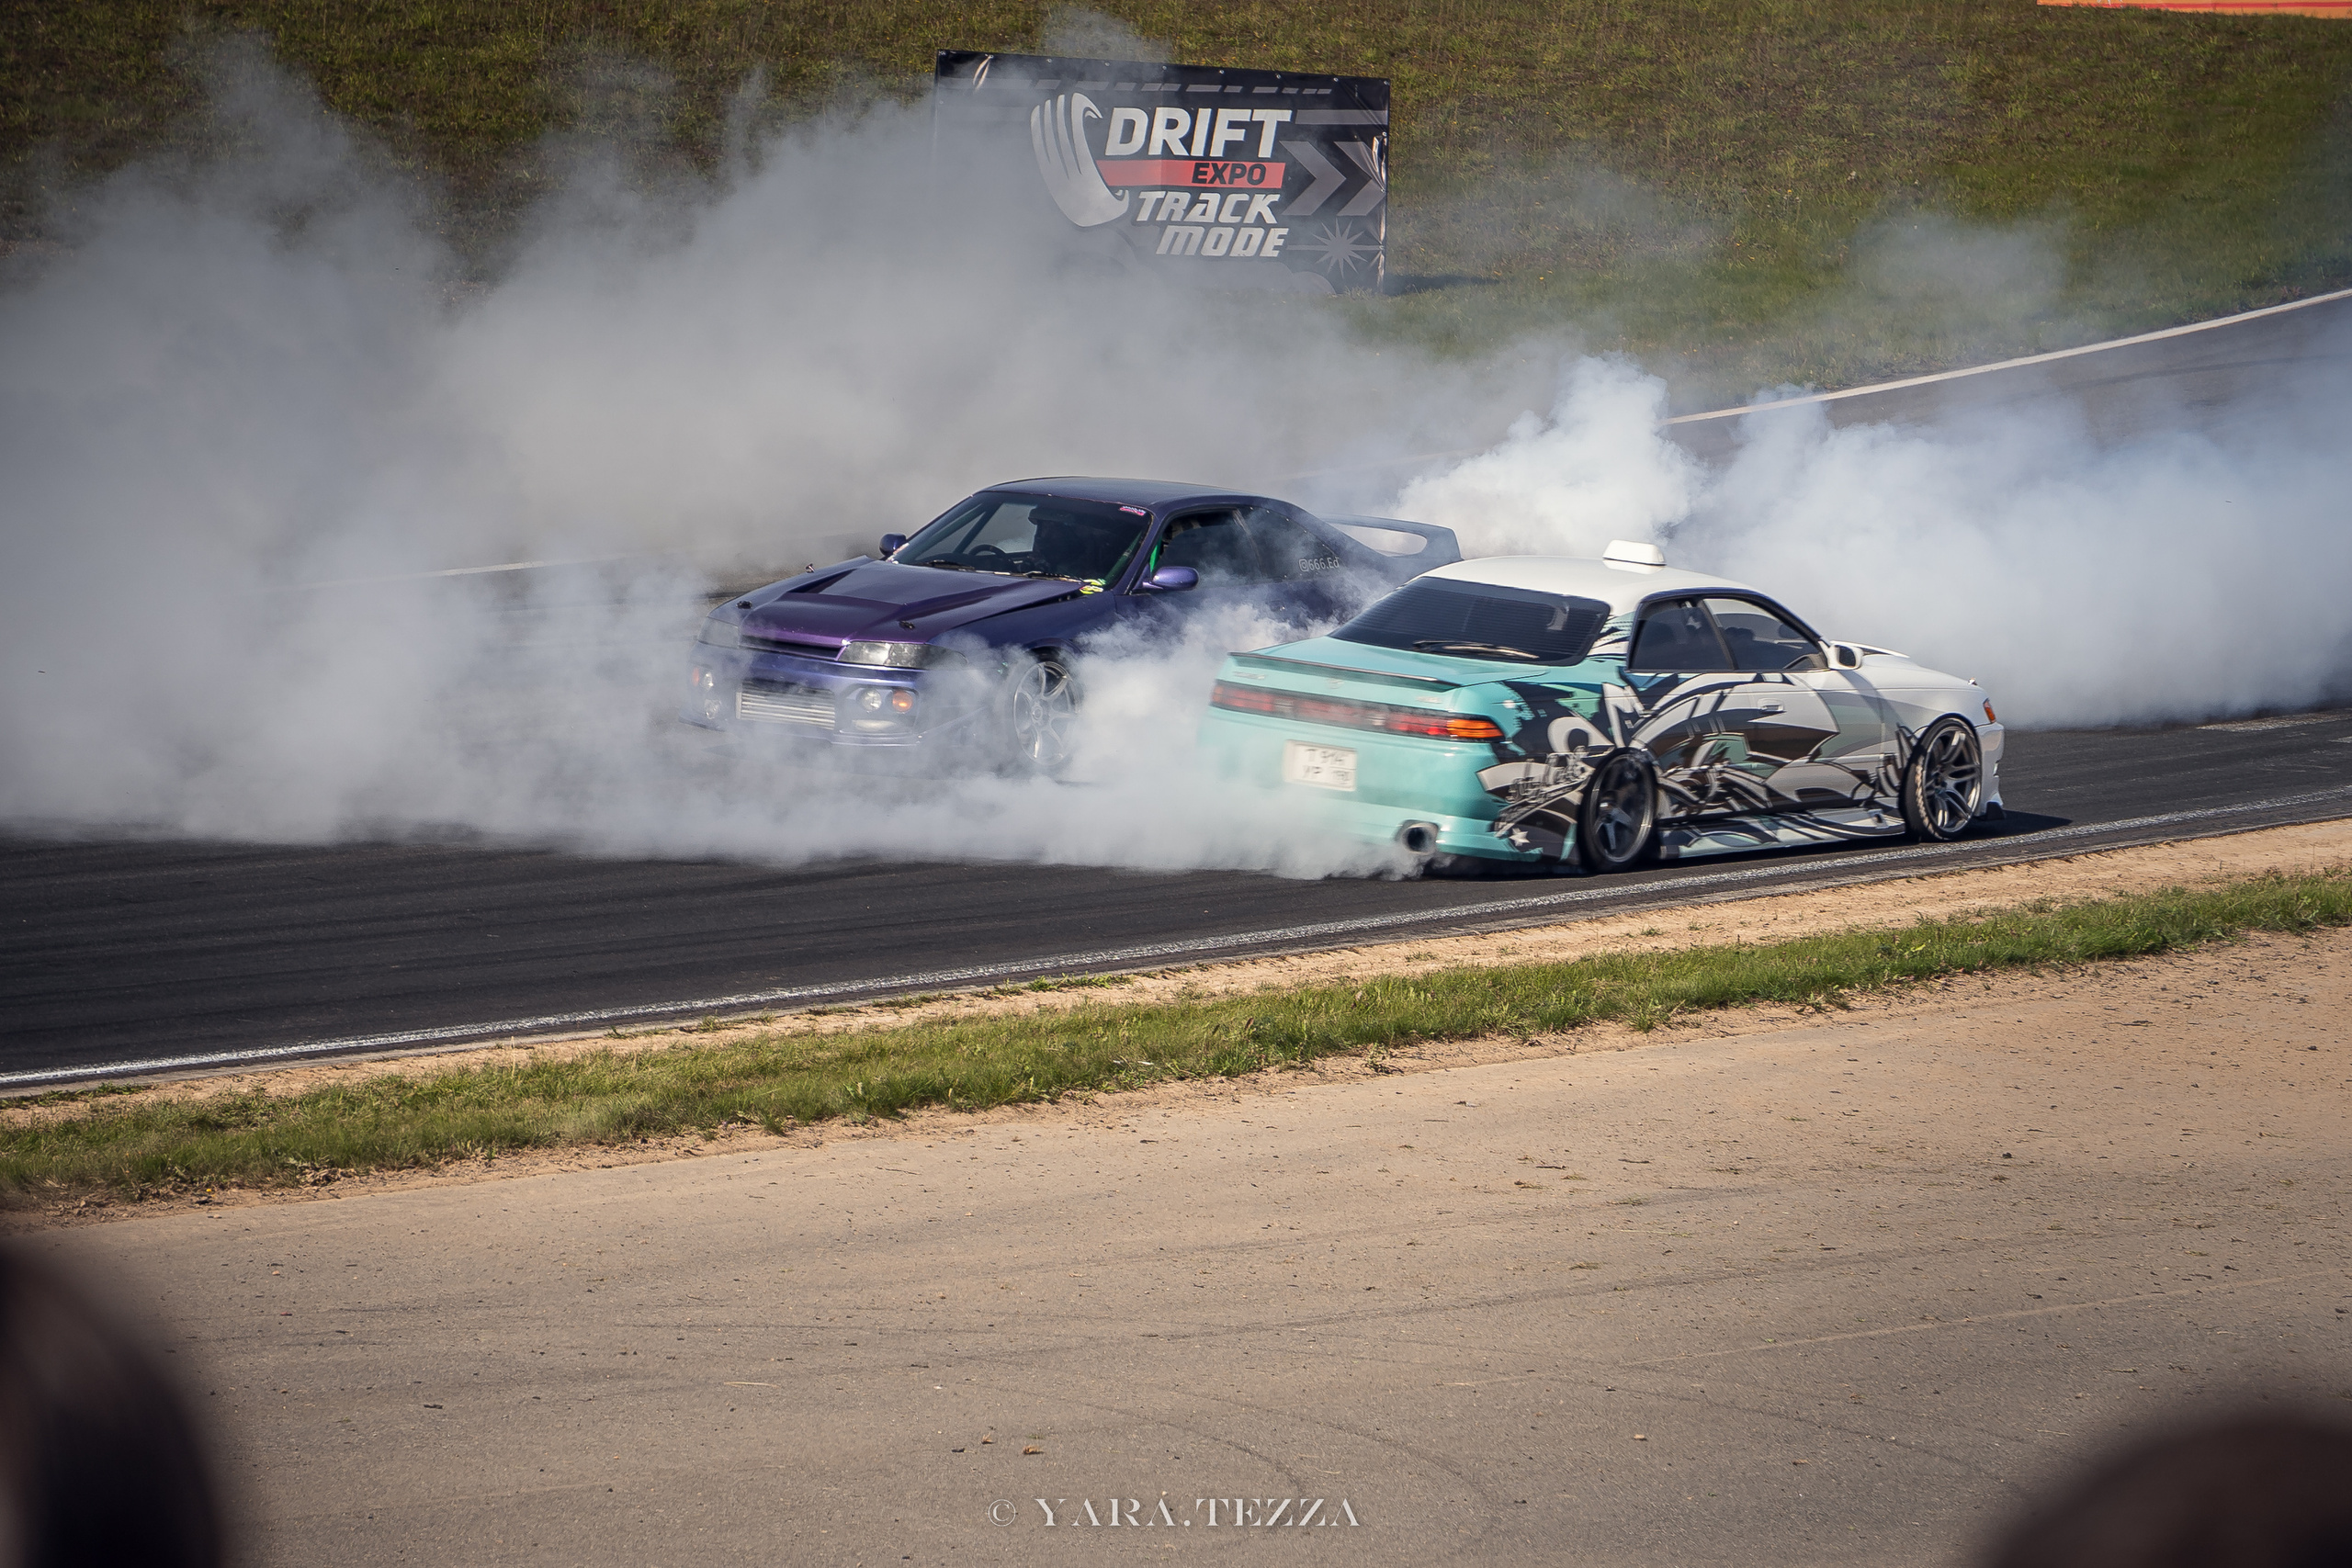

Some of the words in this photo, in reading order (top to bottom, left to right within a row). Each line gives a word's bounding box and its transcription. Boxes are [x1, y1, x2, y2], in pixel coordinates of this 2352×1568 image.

[1105, 107, 1292, 158] DRIFT
[1192, 162, 1267, 186] EXPO
[1136, 189, 1280, 224] TRACK
[1155, 226, 1288, 258] MODE
